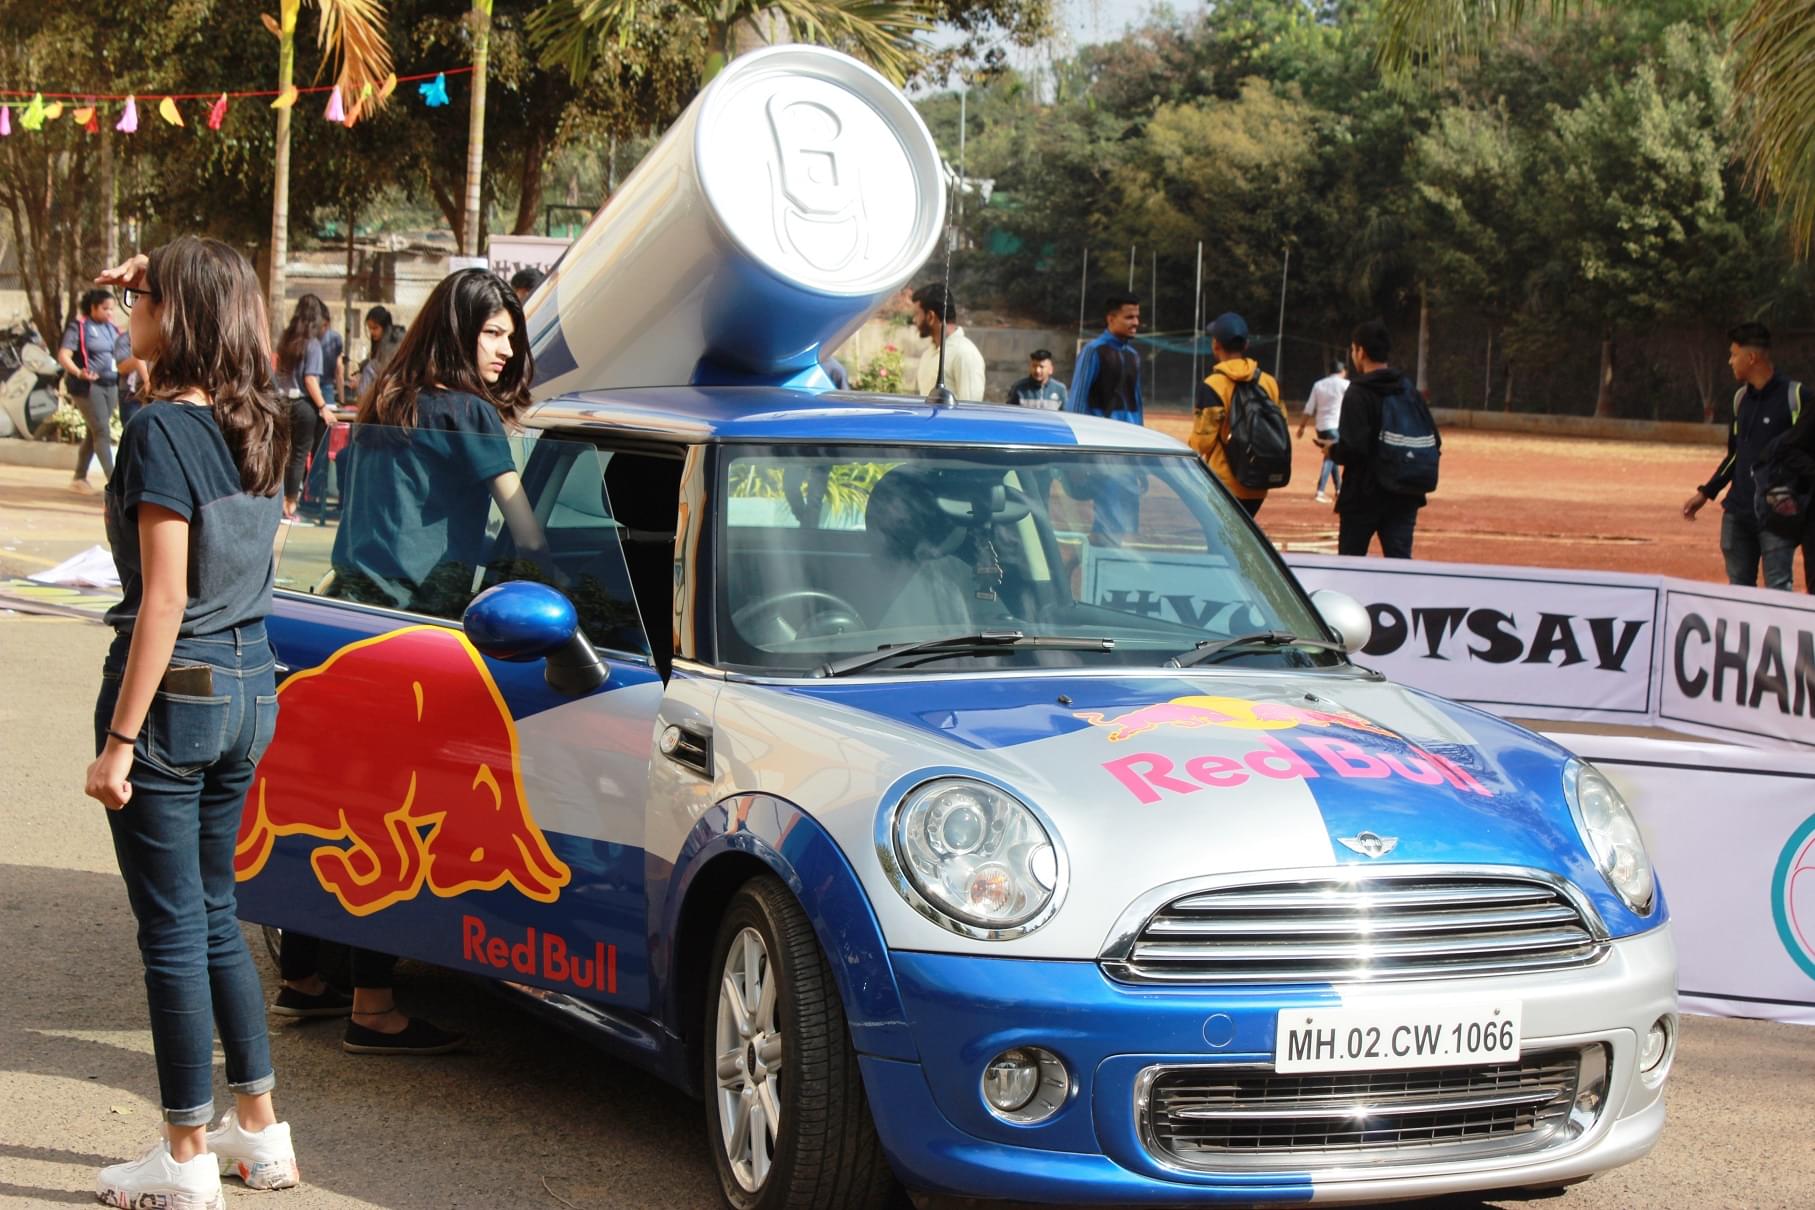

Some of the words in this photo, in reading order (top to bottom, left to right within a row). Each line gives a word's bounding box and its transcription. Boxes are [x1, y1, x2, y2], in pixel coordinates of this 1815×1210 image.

[1101, 735, 1319, 804] Red
[1299, 736, 1493, 797] Bull
[463, 915, 536, 976] Red
[543, 932, 617, 993] Bull
[1288, 1020, 1514, 1061] MH.02.CW.1066
